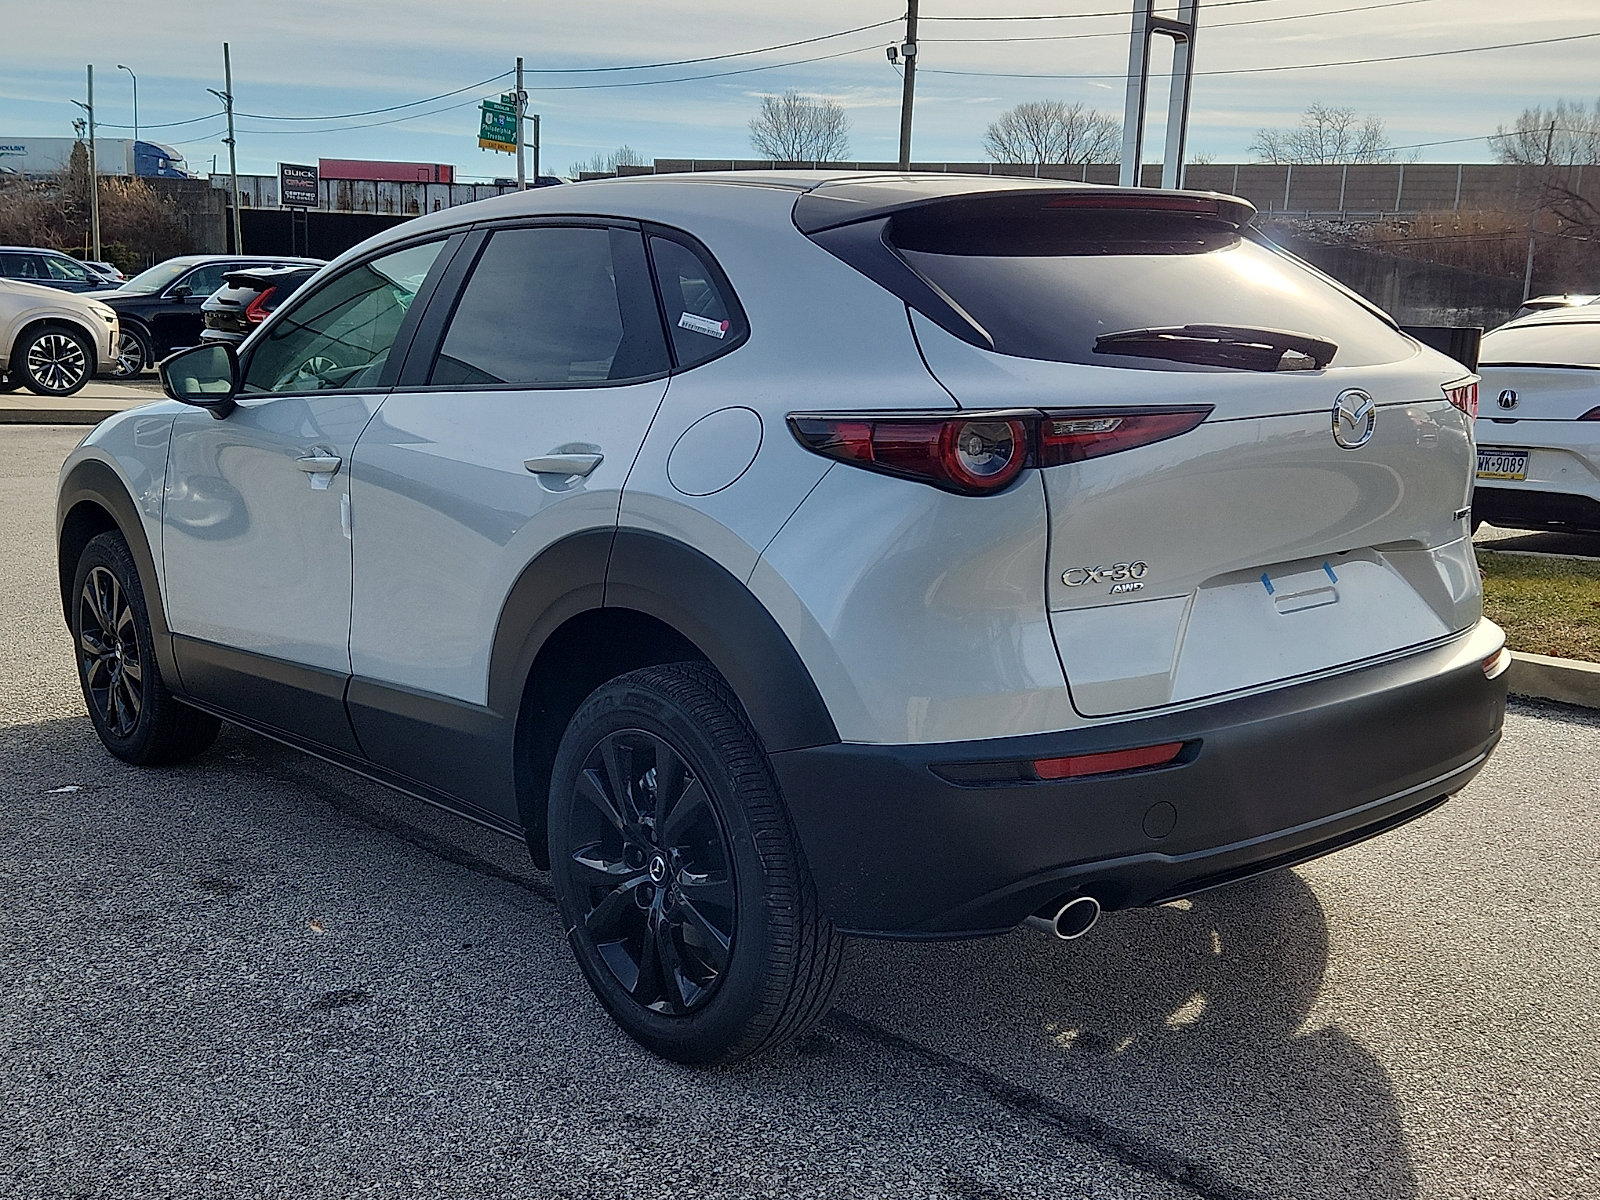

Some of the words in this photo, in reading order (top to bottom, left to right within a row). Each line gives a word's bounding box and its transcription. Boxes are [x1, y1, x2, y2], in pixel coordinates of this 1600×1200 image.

[482, 123, 511, 135] Philadelphia
[487, 132, 506, 141] Trenton
[284, 169, 315, 178] BUICK
[285, 179, 315, 188] GMC
[1477, 456, 1524, 473] WK-9089
[1061, 559, 1149, 587] CX-30
[1109, 581, 1144, 595] AWD
